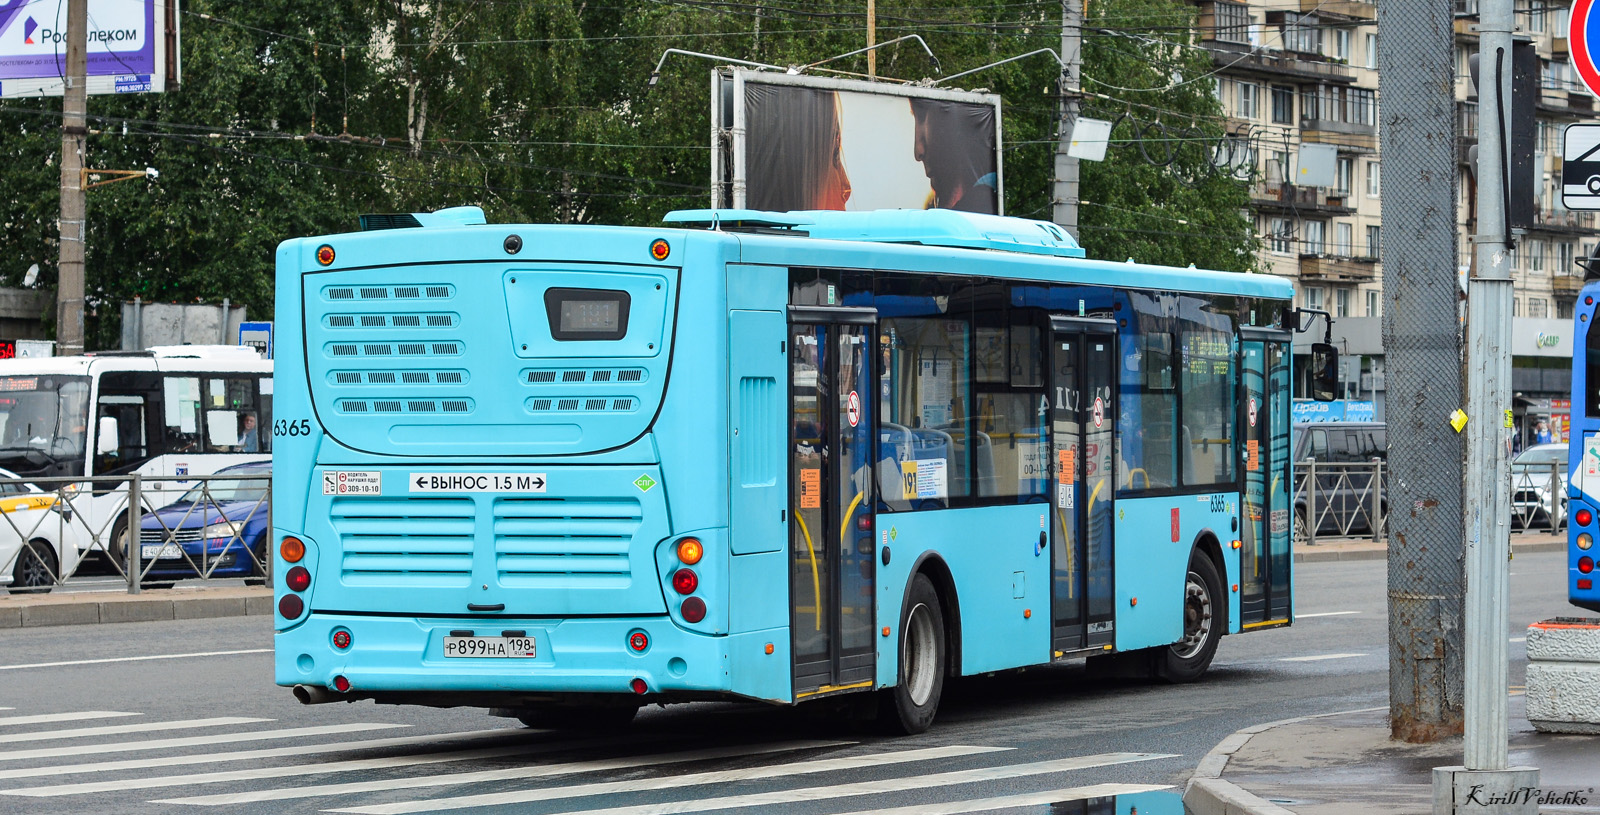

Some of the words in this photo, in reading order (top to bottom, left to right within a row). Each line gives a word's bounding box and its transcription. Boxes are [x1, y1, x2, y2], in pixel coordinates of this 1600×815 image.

[41, 29, 137, 44] Рослеком
[273, 419, 311, 437] 6365
[431, 476, 488, 490] ВЫНОС
[494, 476, 512, 490] 1.5
[517, 477, 530, 490] М
[637, 479, 652, 487] СПГ
[903, 472, 917, 494] 191
[1210, 494, 1225, 513] 6365
[508, 639, 531, 651] 198
